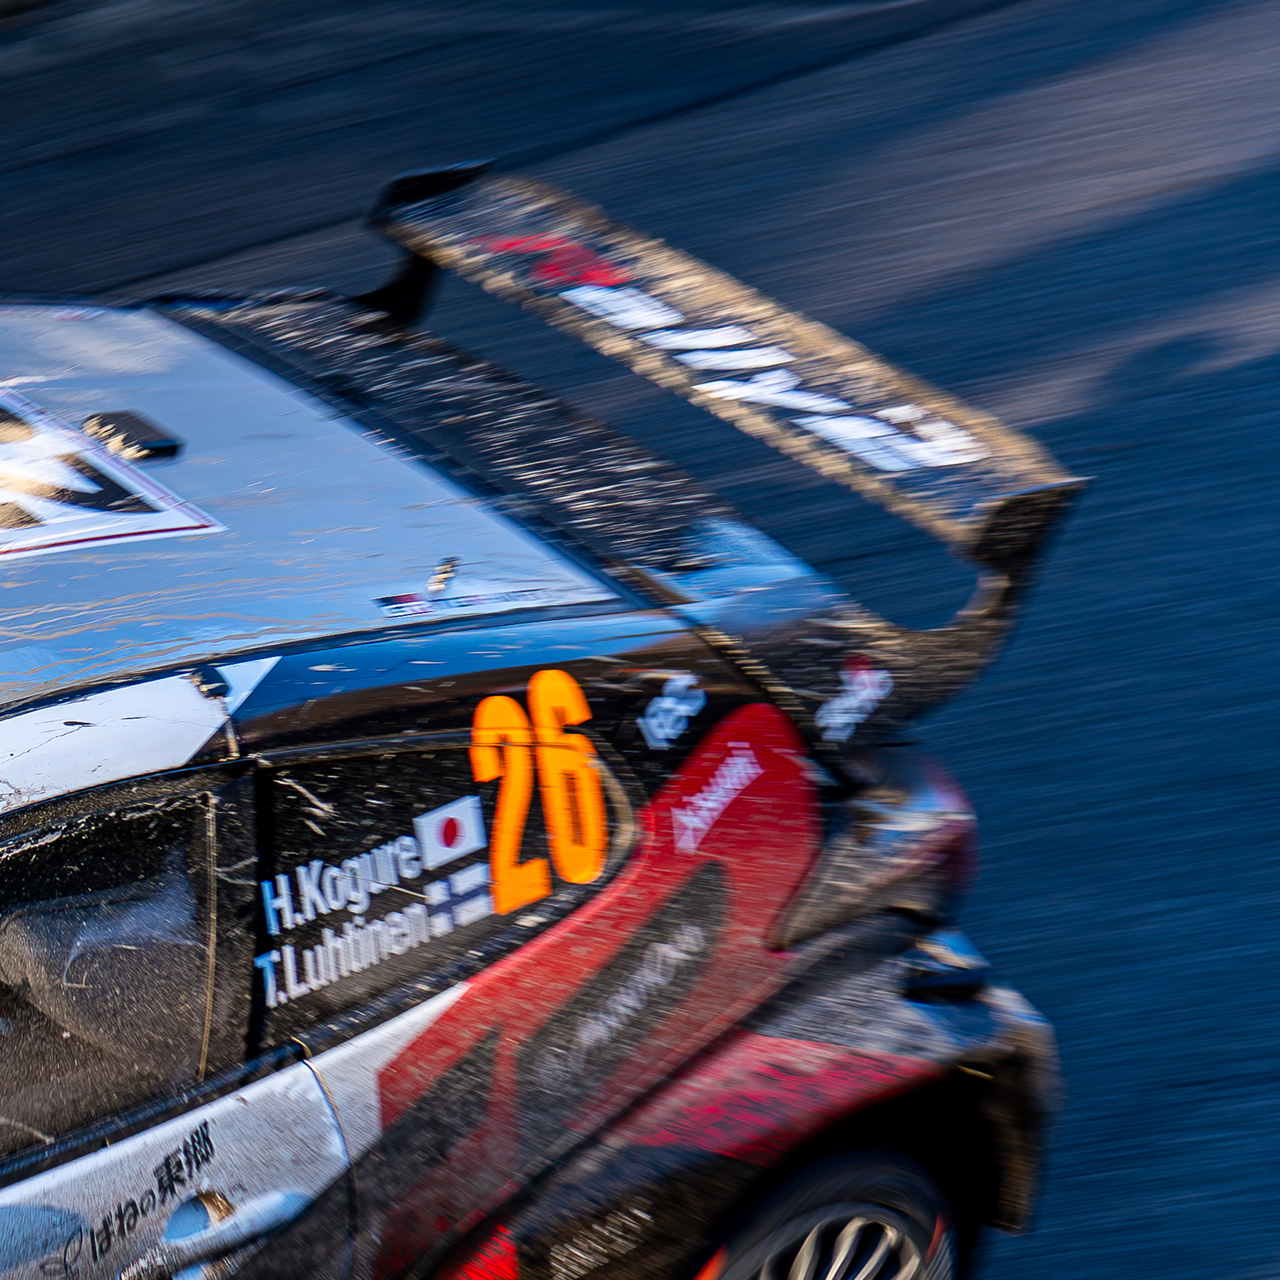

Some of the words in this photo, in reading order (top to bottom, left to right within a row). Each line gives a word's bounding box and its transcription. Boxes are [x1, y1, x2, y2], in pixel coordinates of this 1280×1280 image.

[470, 668, 610, 915] 26
[262, 836, 423, 935] H.Kogure
[254, 900, 432, 1009] T.Luhtinen
